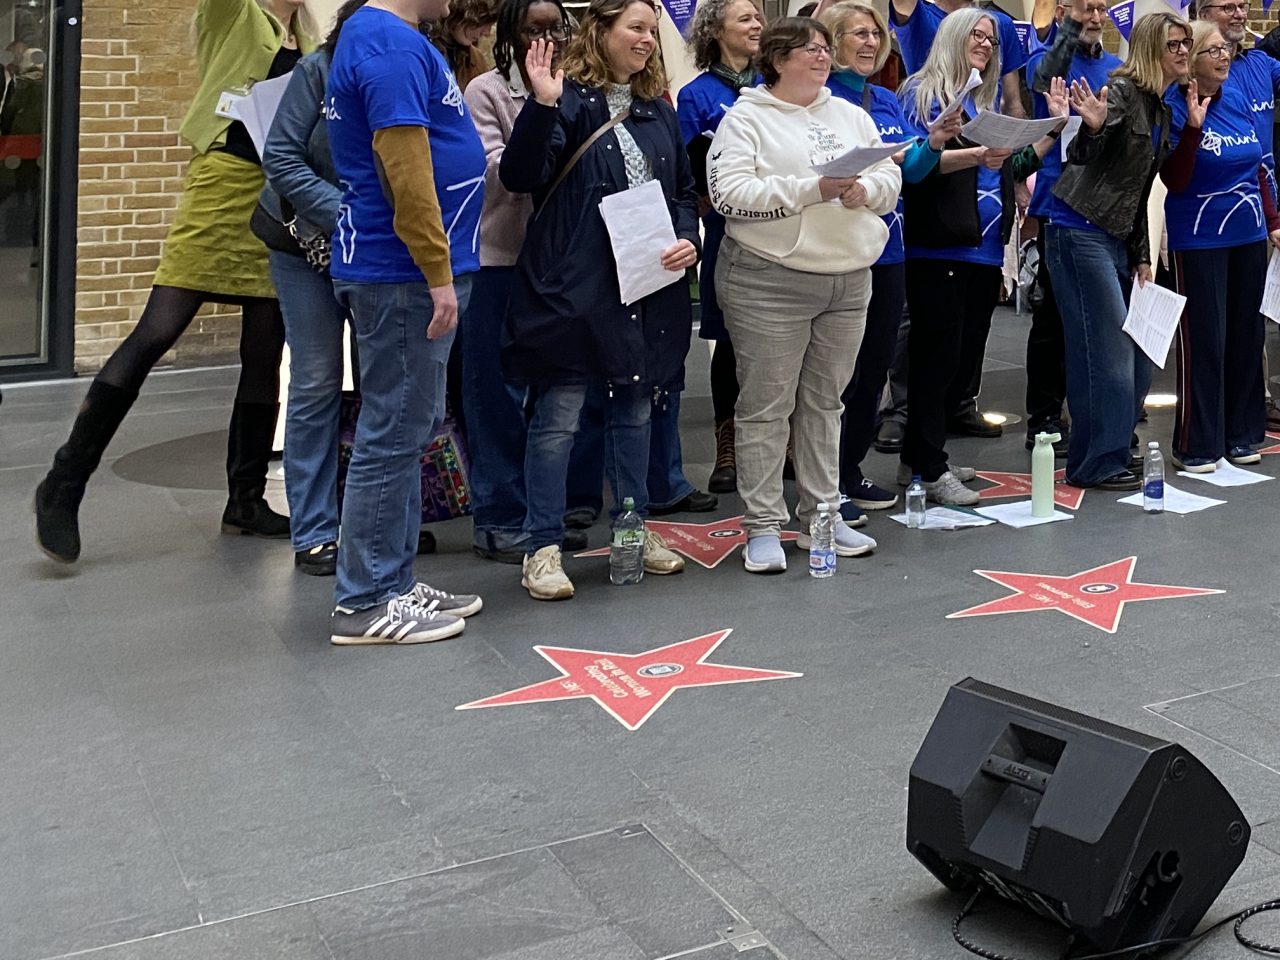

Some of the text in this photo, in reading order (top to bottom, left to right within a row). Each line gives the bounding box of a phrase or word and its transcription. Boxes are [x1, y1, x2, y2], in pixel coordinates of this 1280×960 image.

[1219, 129, 1259, 147] mind
[584, 664, 629, 698] Celebrating
[1005, 763, 1031, 778] ALTO
